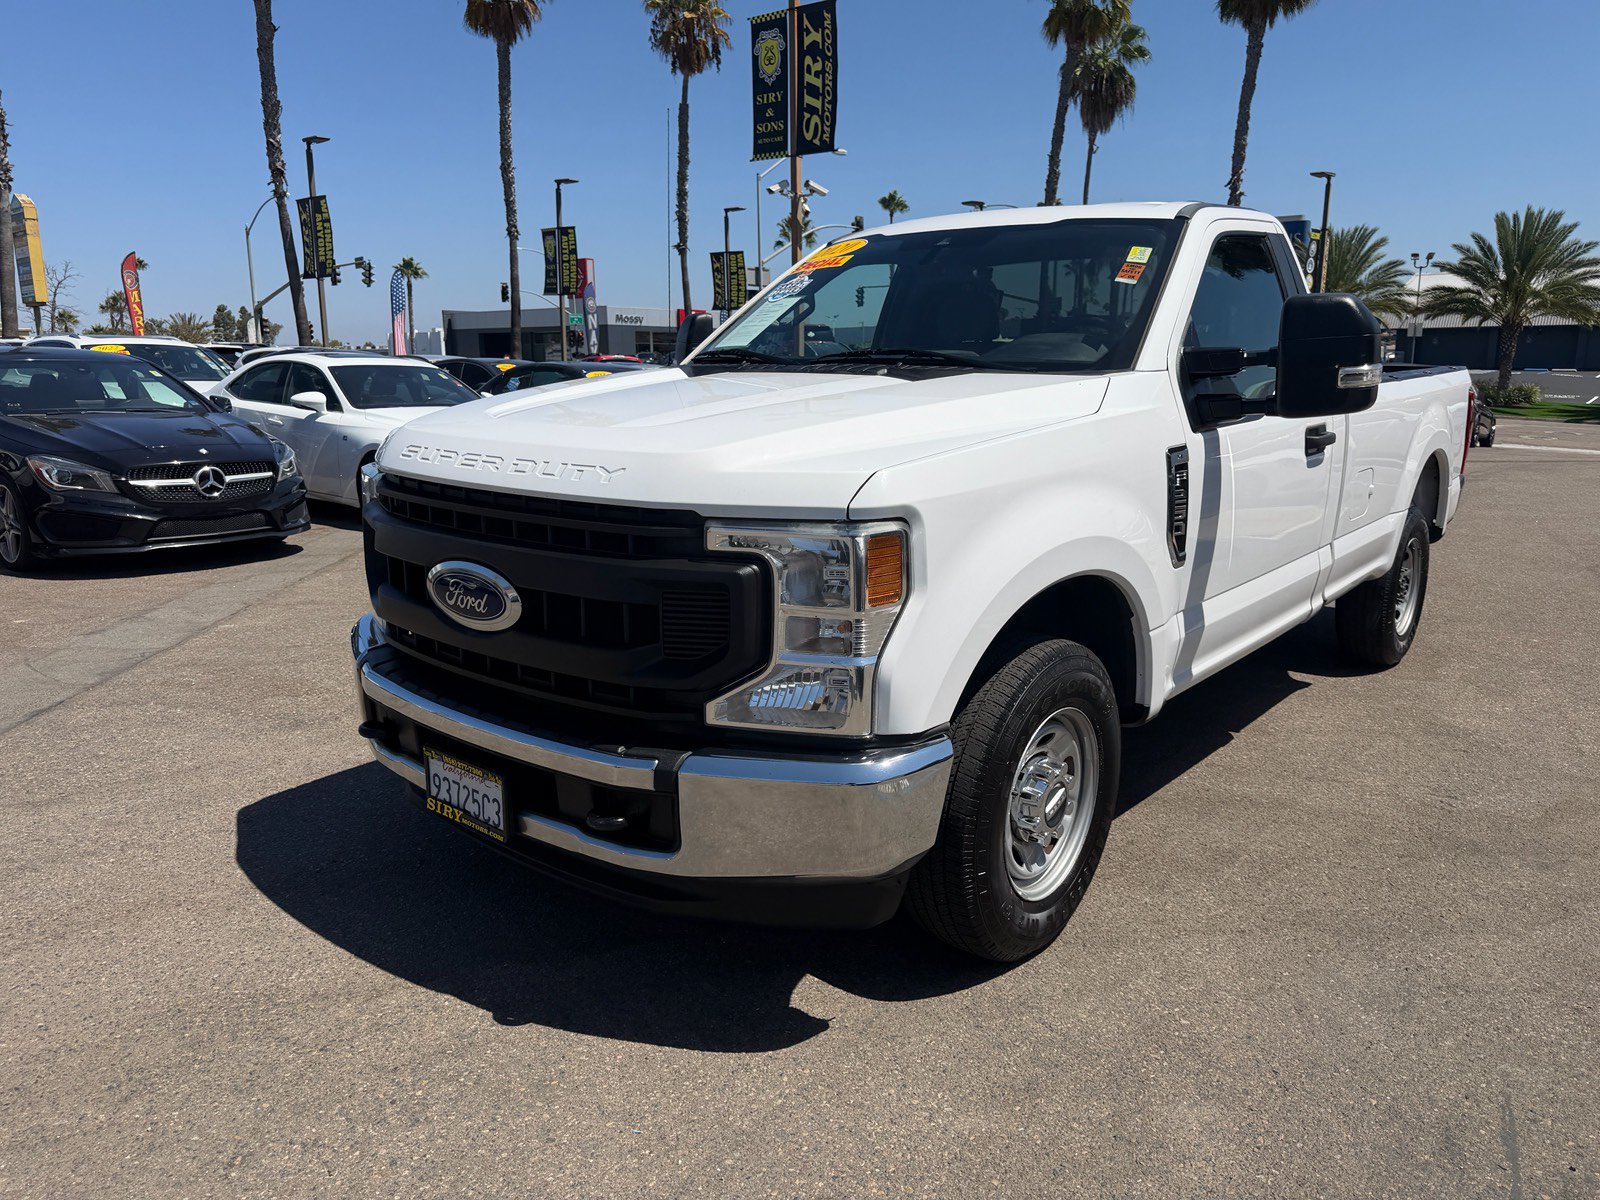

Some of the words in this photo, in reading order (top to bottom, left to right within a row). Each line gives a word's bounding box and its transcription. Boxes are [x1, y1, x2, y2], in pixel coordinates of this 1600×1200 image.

[803, 13, 823, 146] SIRY
[823, 10, 833, 144] MOTORS.COM
[756, 91, 784, 105] SIRY
[765, 108, 775, 117] &
[756, 120, 784, 134] SONS
[770, 135, 784, 143] CARE
[320, 198, 329, 220] WE
[315, 213, 325, 263] ANYONE
[324, 222, 333, 275] FINANCE
[561, 235, 569, 261] AUTO
[568, 228, 576, 251] FULL
[737, 253, 744, 267] WE
[562, 264, 570, 288] CARE
[738, 269, 746, 307] SUPPORT
[615, 314, 644, 325] Mossy
[400, 444, 505, 473] SUPER
[506, 458, 627, 484] DUTY
[445, 578, 489, 614] Ford
[426, 797, 463, 823] SIRY
[432, 772, 501, 828] 93725C3
